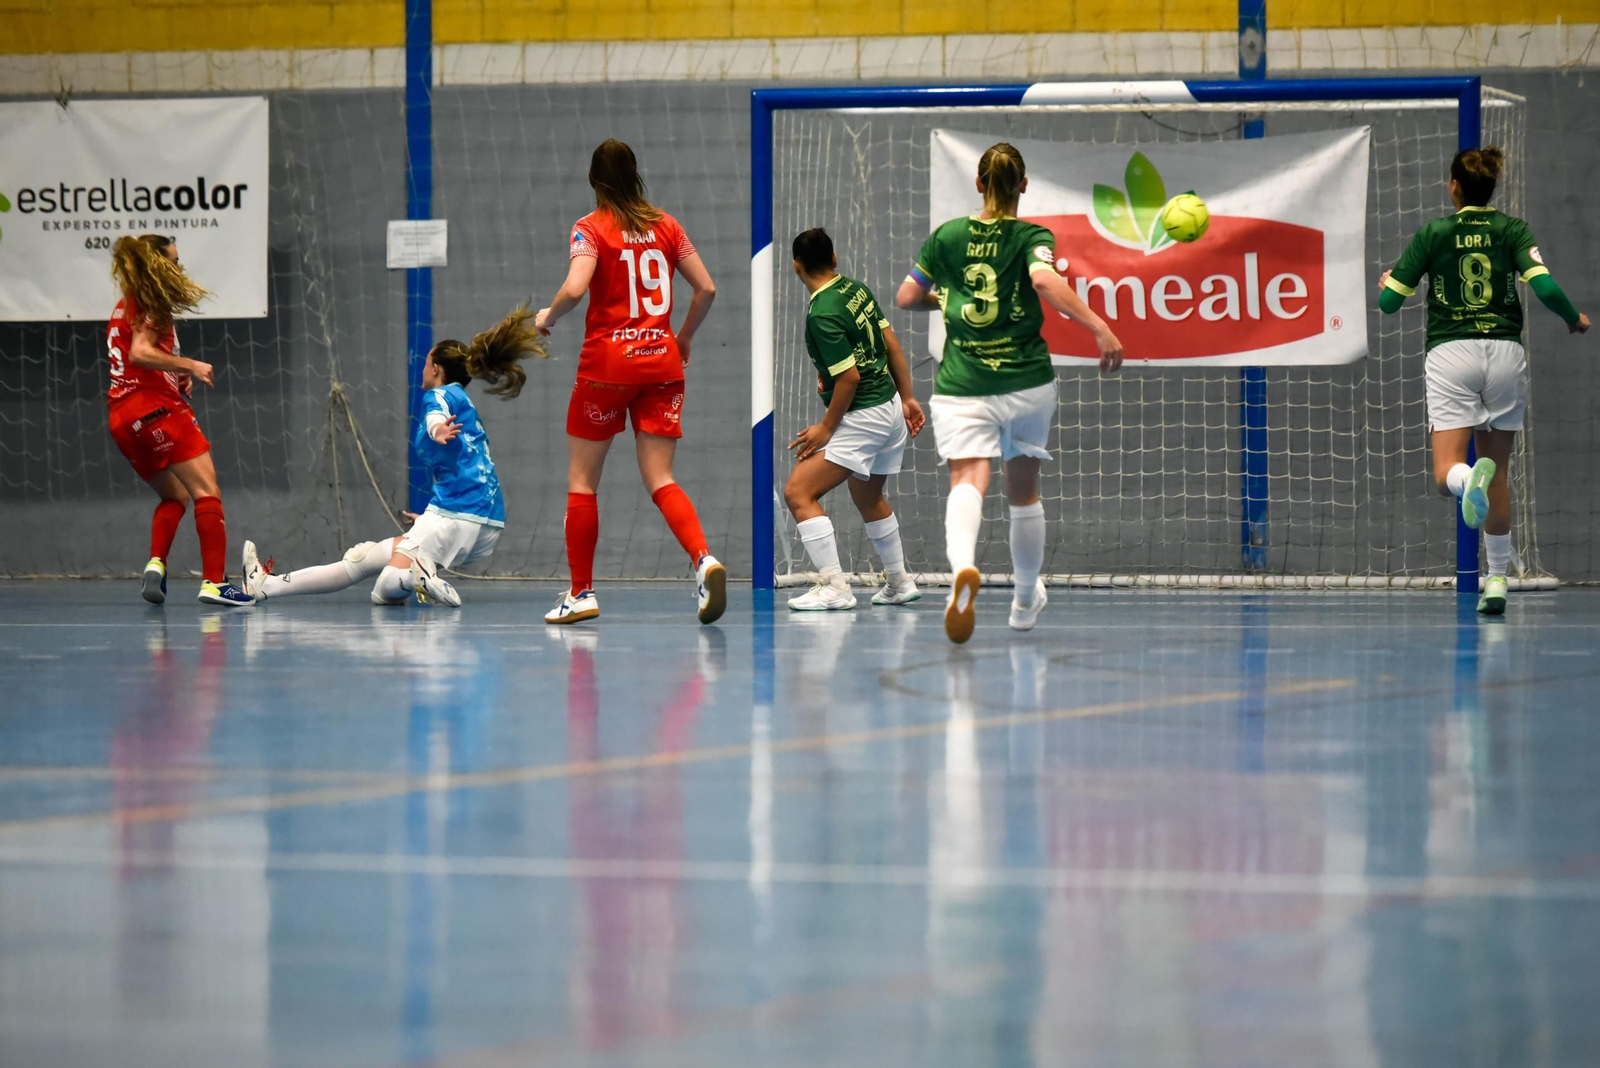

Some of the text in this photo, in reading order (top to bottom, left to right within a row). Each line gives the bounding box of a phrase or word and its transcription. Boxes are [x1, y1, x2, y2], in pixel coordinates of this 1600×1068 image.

[17, 177, 248, 213] estrellacolor
[42, 217, 219, 231] EXPERTOS EN PINTURA
[1455, 234, 1492, 248] LORA
[85, 237, 110, 249] 620
[619, 249, 671, 318] 19
[961, 263, 999, 328] 3
[1459, 253, 1493, 308] 8
